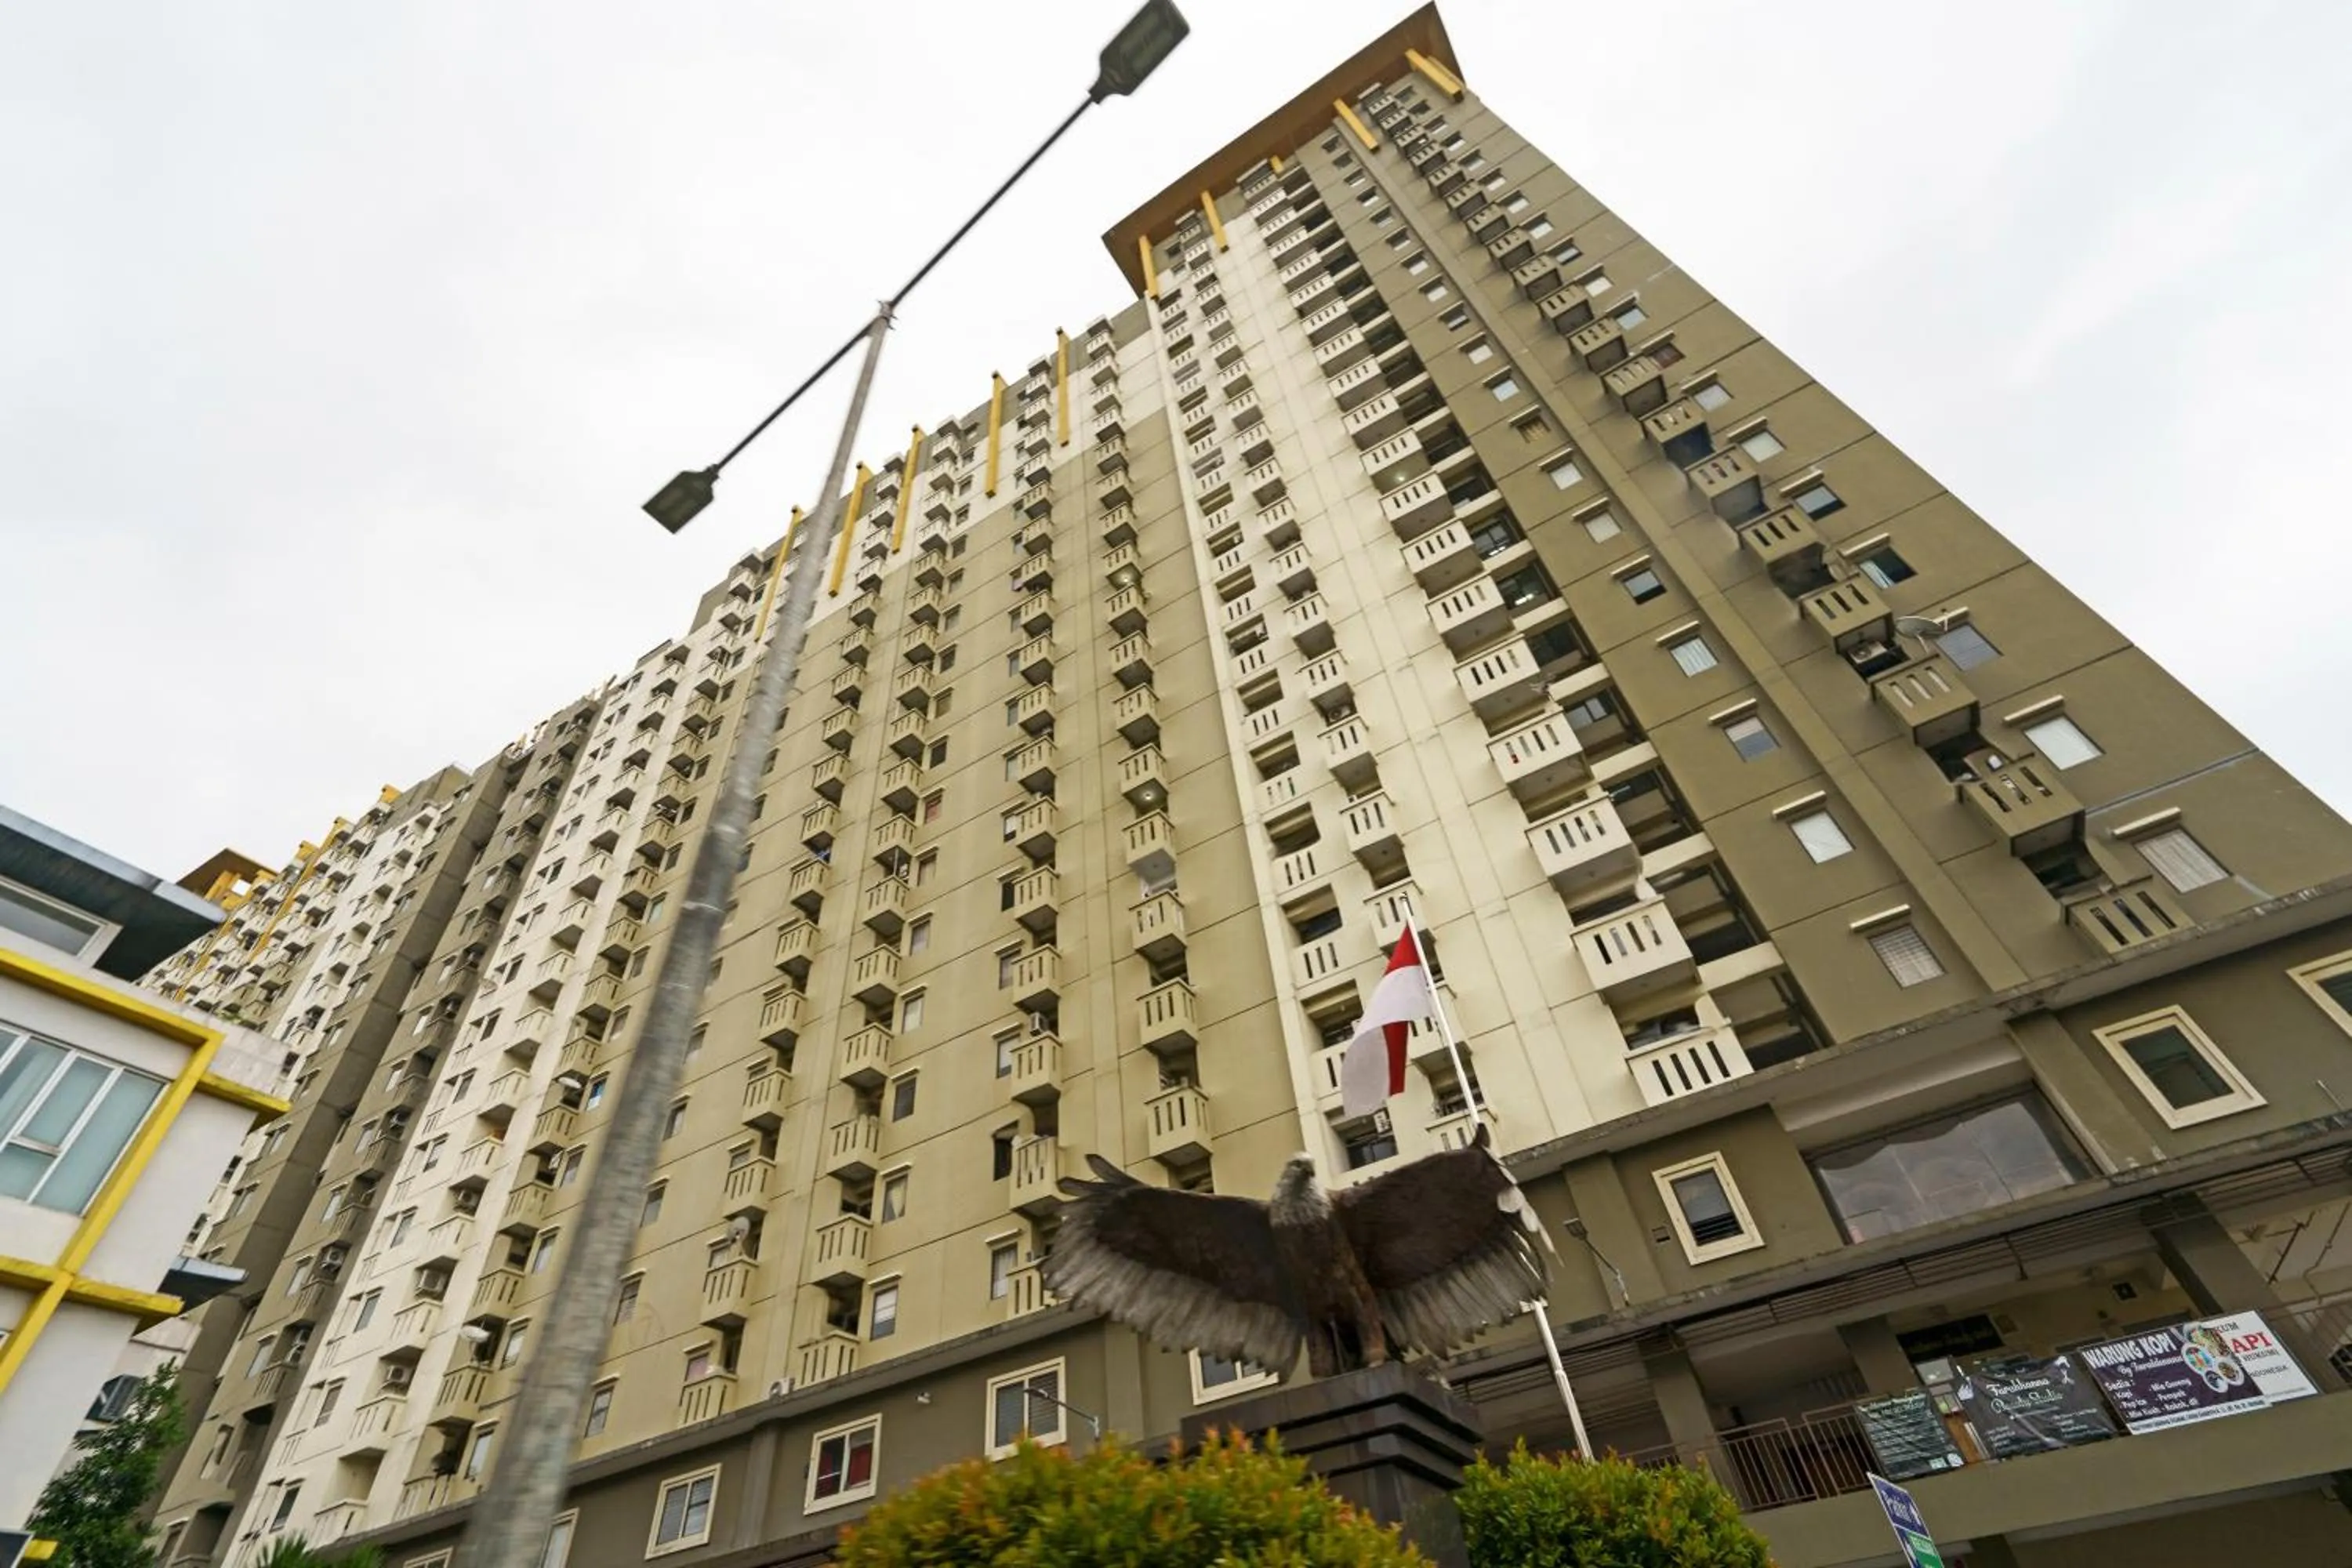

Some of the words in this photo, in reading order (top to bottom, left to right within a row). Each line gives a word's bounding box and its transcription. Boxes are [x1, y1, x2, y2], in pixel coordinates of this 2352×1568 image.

[2217, 1321, 2239, 1334] KUM
[2082, 1340, 2144, 1370] WARUNG
[2138, 1332, 2178, 1357] KOPI
[2230, 1330, 2272, 1354] API
[2246, 1364, 2288, 1377] NDONESIA
